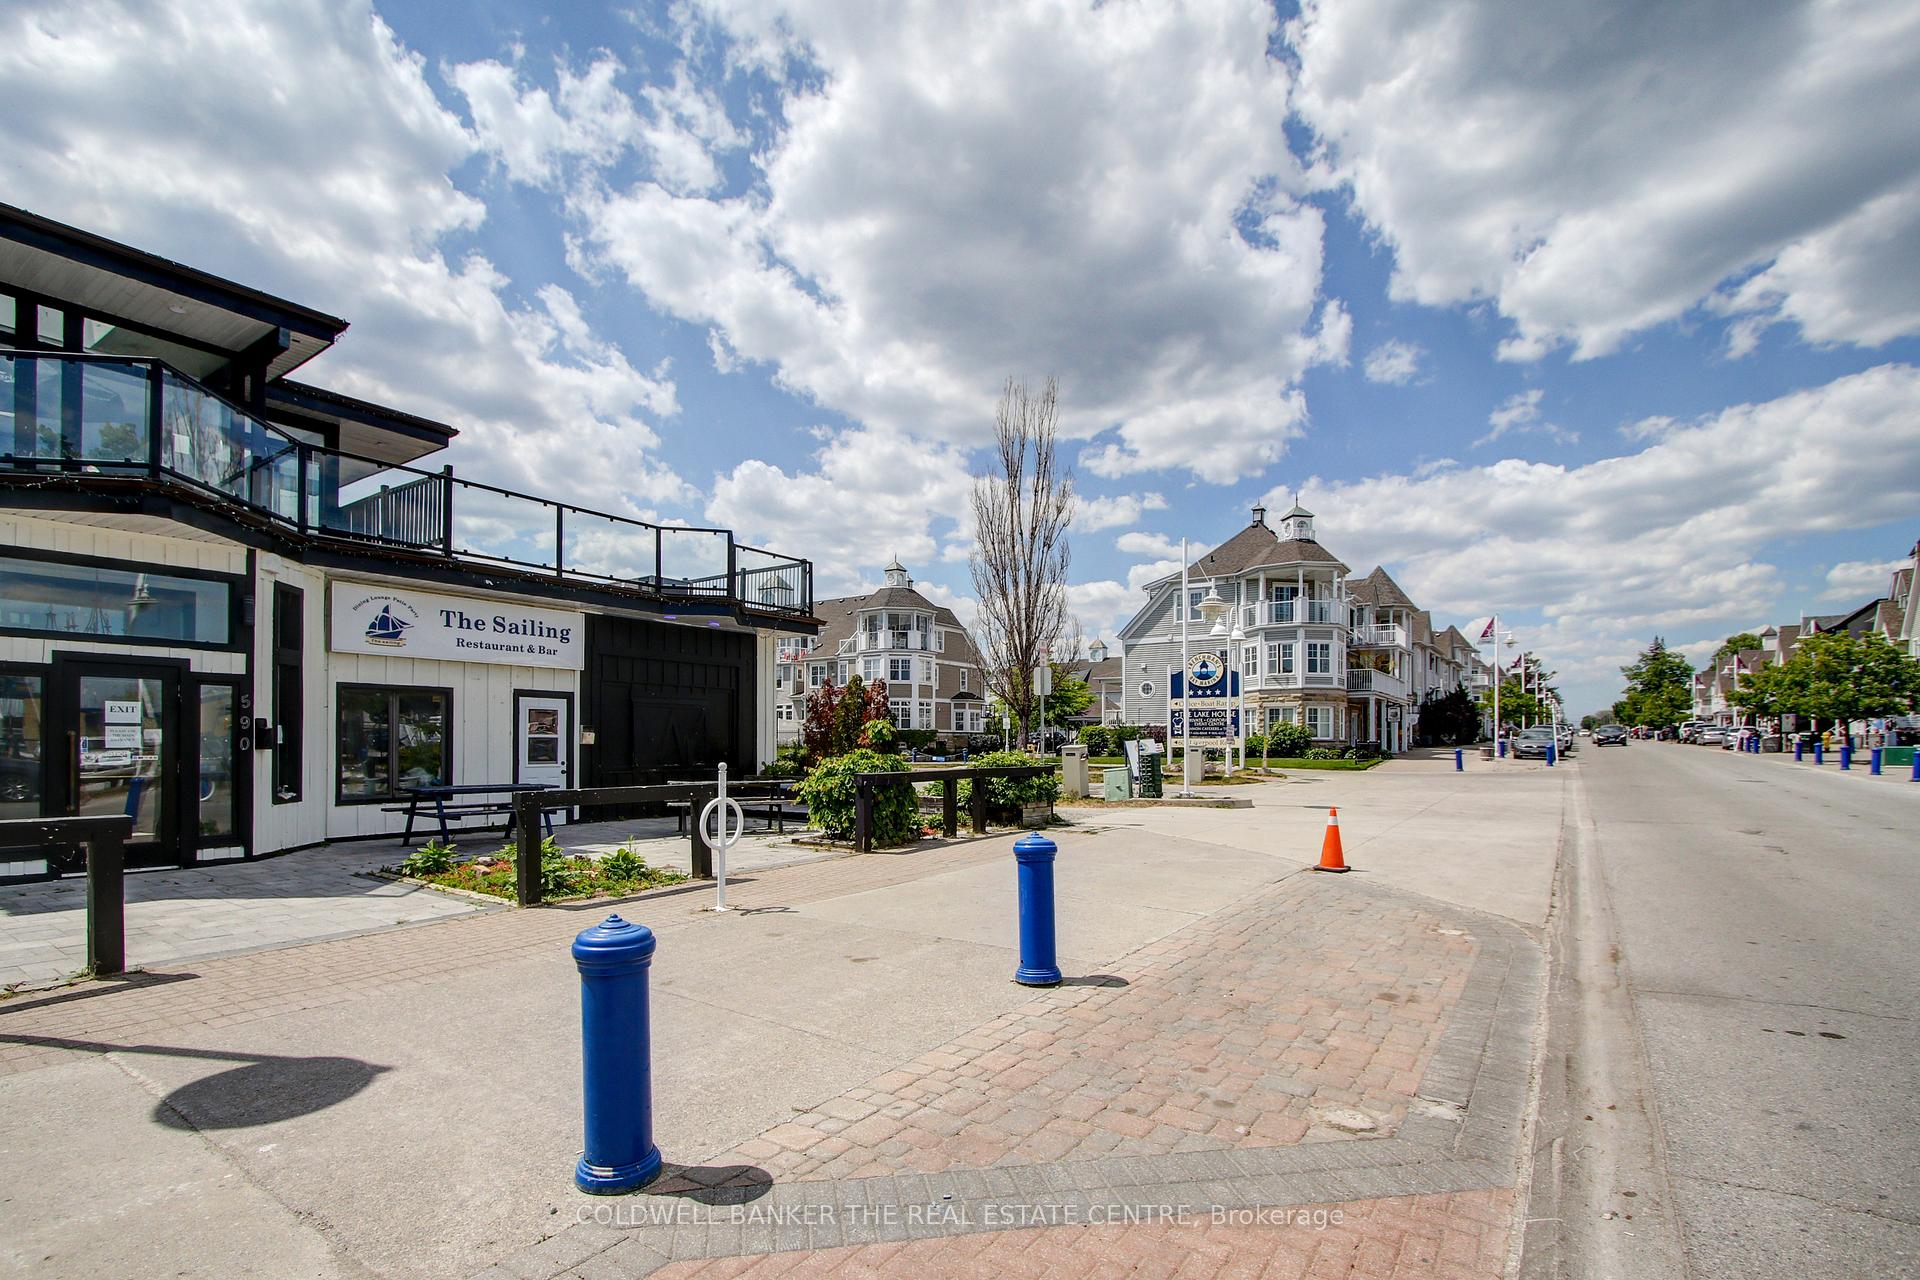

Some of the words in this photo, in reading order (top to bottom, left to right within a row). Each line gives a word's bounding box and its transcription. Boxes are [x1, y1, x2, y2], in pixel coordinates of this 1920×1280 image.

[440, 609, 486, 631] The
[493, 615, 571, 644] Sailing
[456, 637, 525, 653] Restaurant
[527, 644, 535, 653] &
[538, 645, 558, 656] Bar
[110, 705, 137, 713] EXIT
